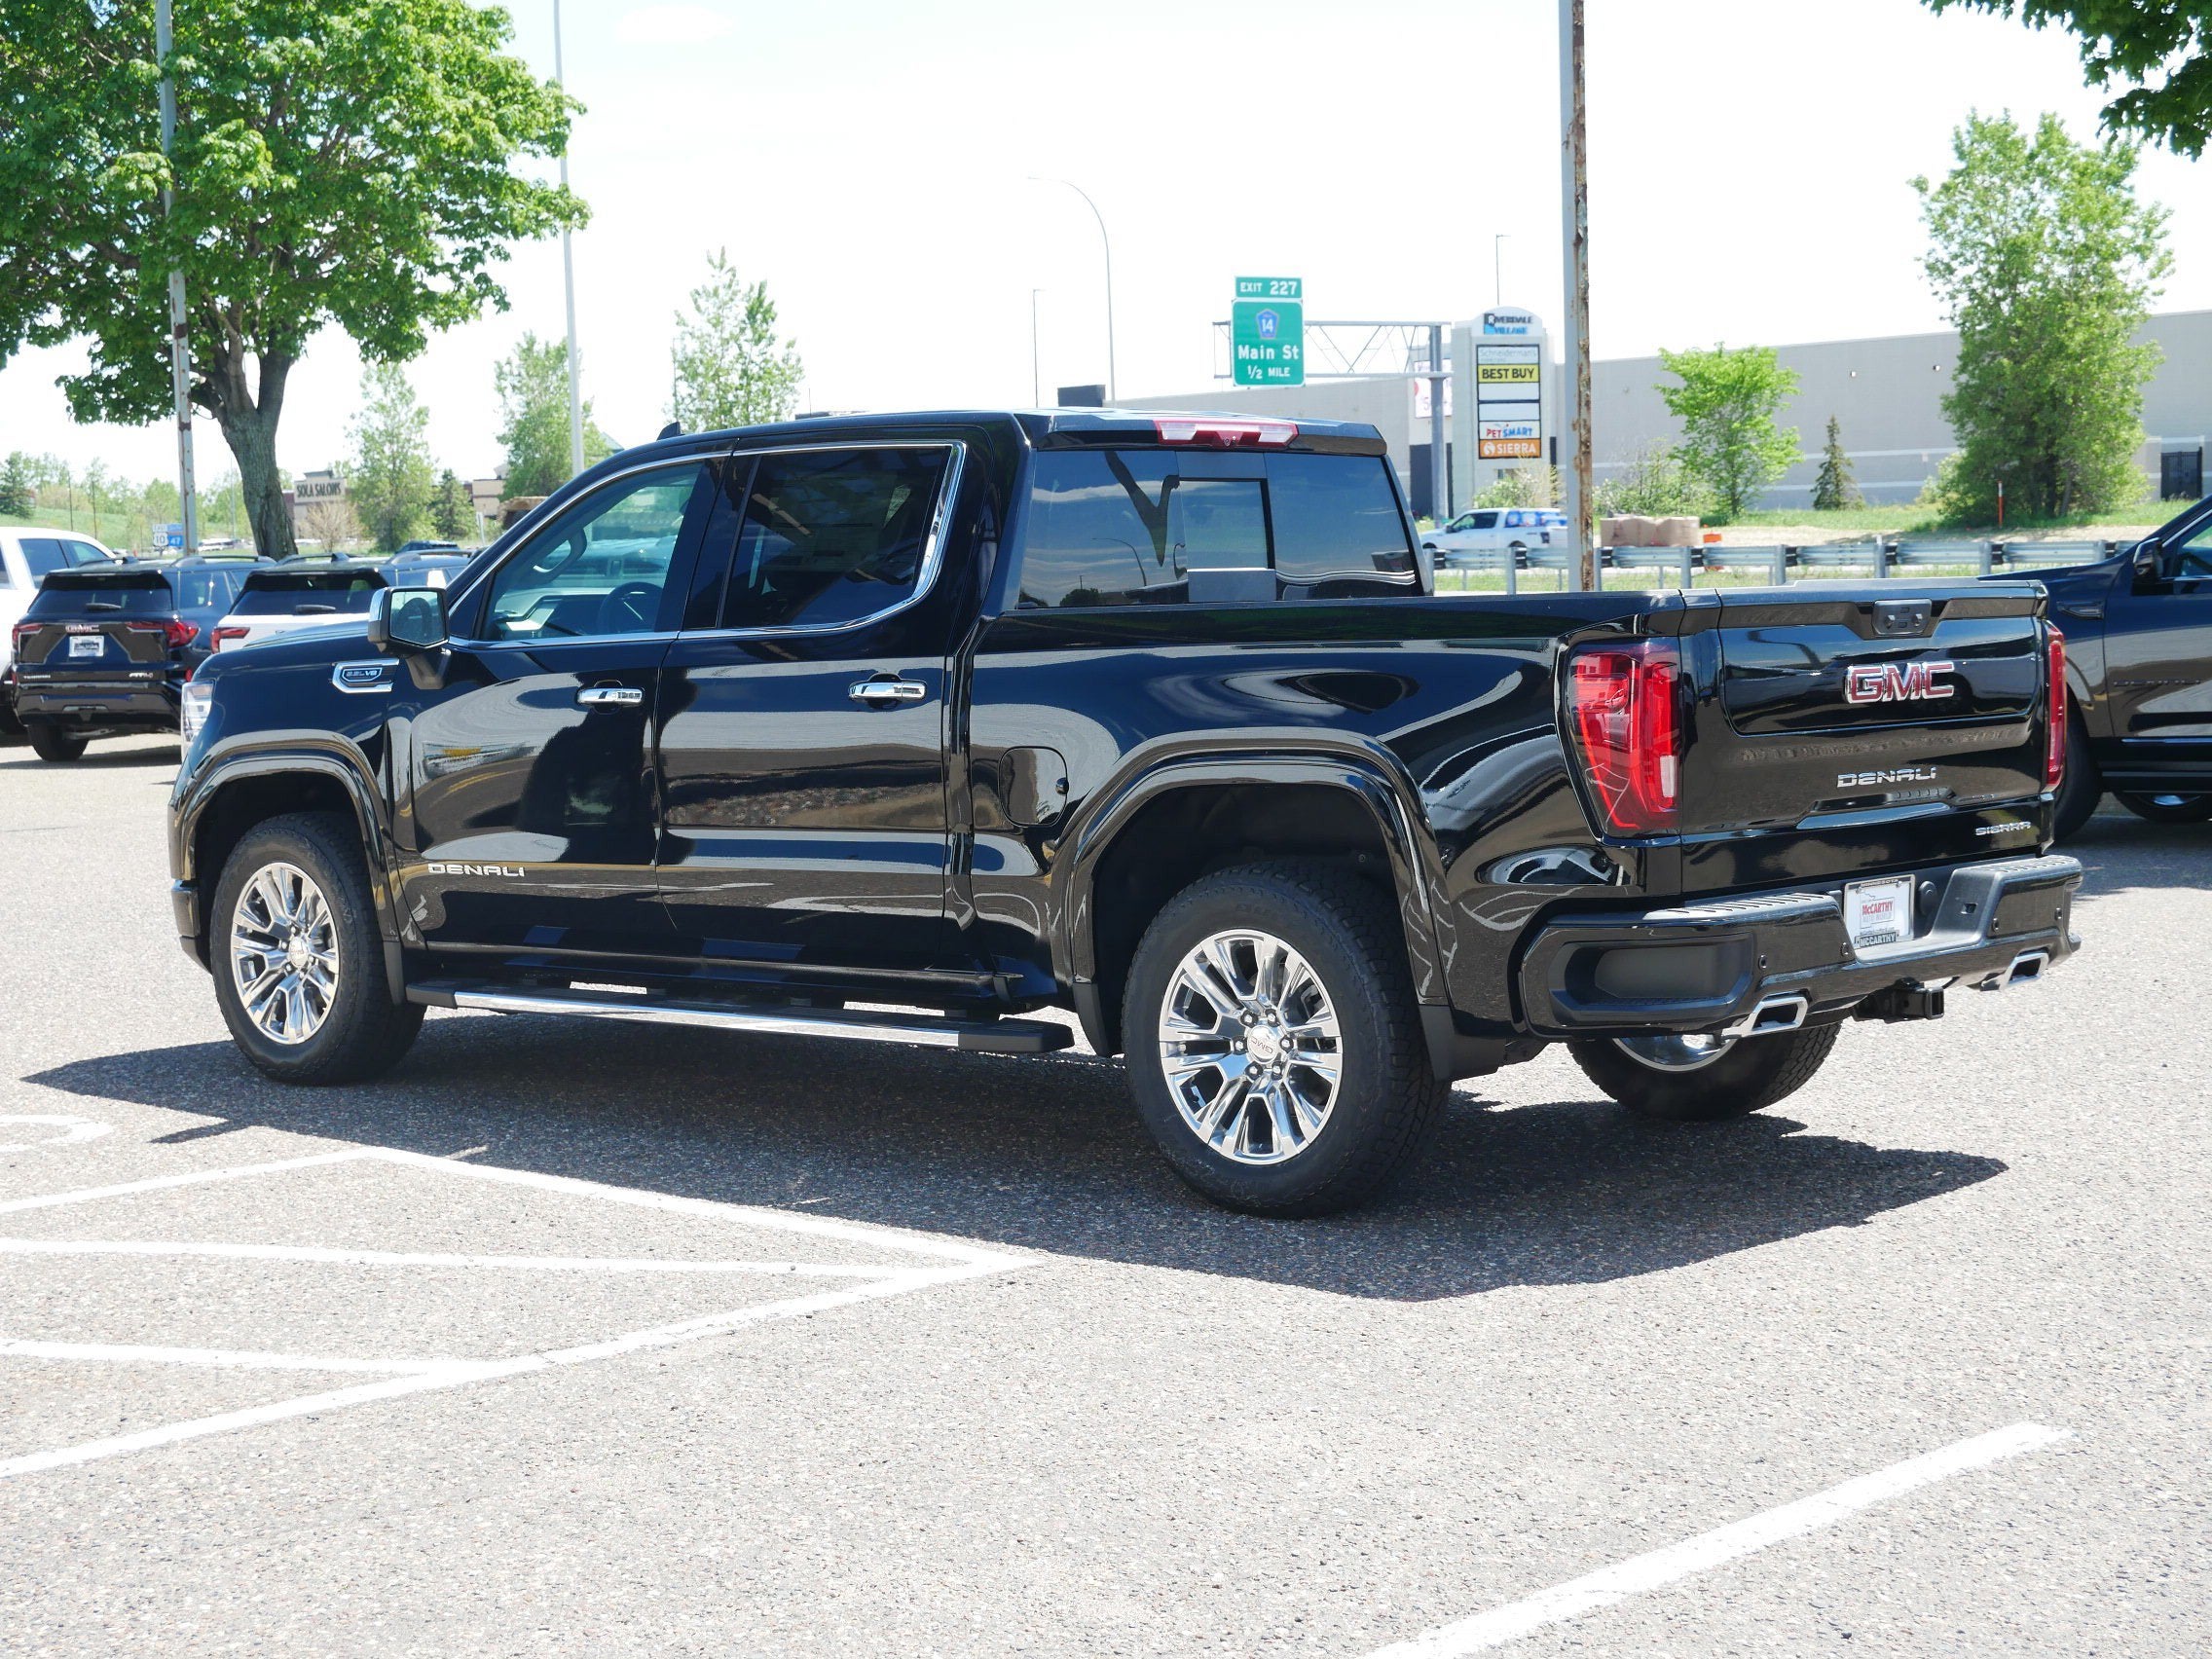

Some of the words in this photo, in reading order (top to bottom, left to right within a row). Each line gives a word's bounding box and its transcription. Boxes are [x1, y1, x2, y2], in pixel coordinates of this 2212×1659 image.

[1239, 281, 1263, 293] EXIT
[1270, 280, 1298, 296] 227
[1262, 318, 1273, 333] 14
[1237, 344, 1274, 360] Main
[1282, 344, 1300, 360] St
[1268, 367, 1291, 378] MILE
[1482, 368, 1509, 380] BEST
[1512, 367, 1534, 379] BUY
[1496, 442, 1537, 455] SIERRA
[297, 484, 313, 498] SOLA
[314, 482, 342, 497] SALONS
[156, 535, 166, 544] 10
[170, 536, 181, 545] 47
[1847, 661, 1955, 703] GMC
[1836, 766, 1937, 788] DENALI
[1974, 821, 2032, 836] SIERRA
[427, 863, 526, 877] DENALI
[1862, 901, 1894, 916] McCARTHY
[1251, 1035, 1273, 1054] GMC
